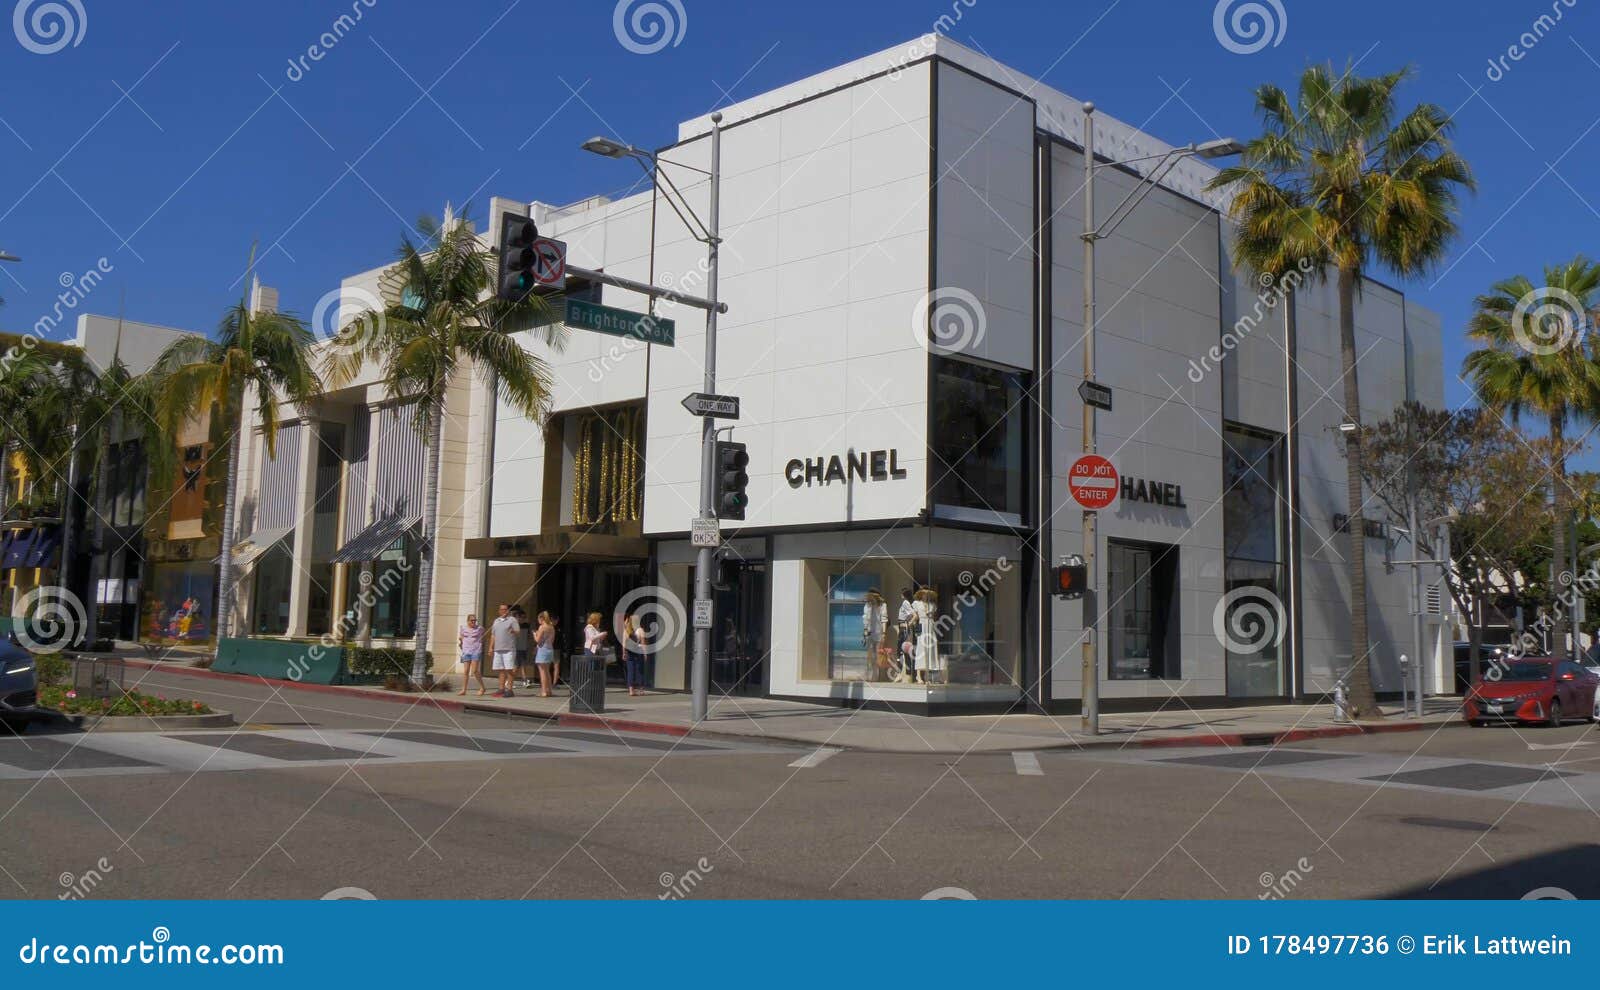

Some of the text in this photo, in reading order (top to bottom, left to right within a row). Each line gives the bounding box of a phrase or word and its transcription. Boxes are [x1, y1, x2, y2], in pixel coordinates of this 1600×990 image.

[571, 306, 672, 342] Brighton ay
[698, 399, 733, 412] ONE WAY
[785, 449, 907, 485] CHANEL
[1076, 464, 1112, 475] DO NOT
[1080, 489, 1108, 500] ENTER
[1120, 475, 1186, 508] HANEL
[694, 534, 705, 544] OK
